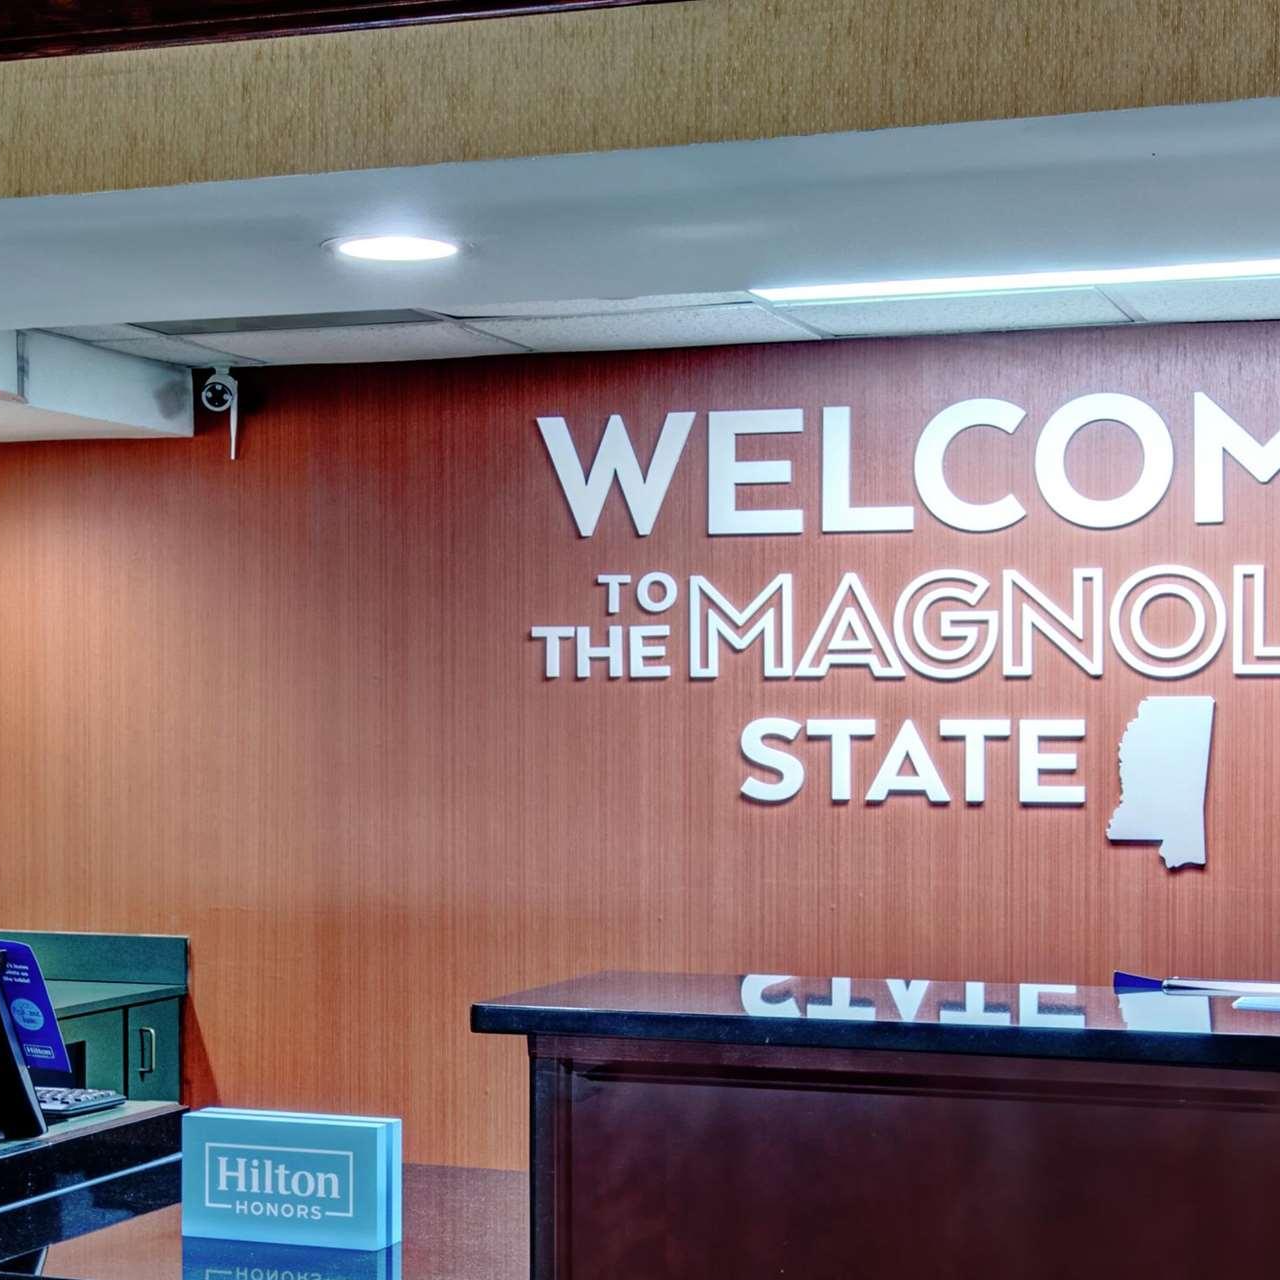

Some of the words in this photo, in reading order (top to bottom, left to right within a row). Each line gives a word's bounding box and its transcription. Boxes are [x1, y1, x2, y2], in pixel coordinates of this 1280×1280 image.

[596, 571, 678, 615] TO
[530, 624, 672, 679] THE
[738, 716, 1086, 805] STATE
[216, 1156, 341, 1200] Hilton
[235, 1200, 322, 1220] HONORS
